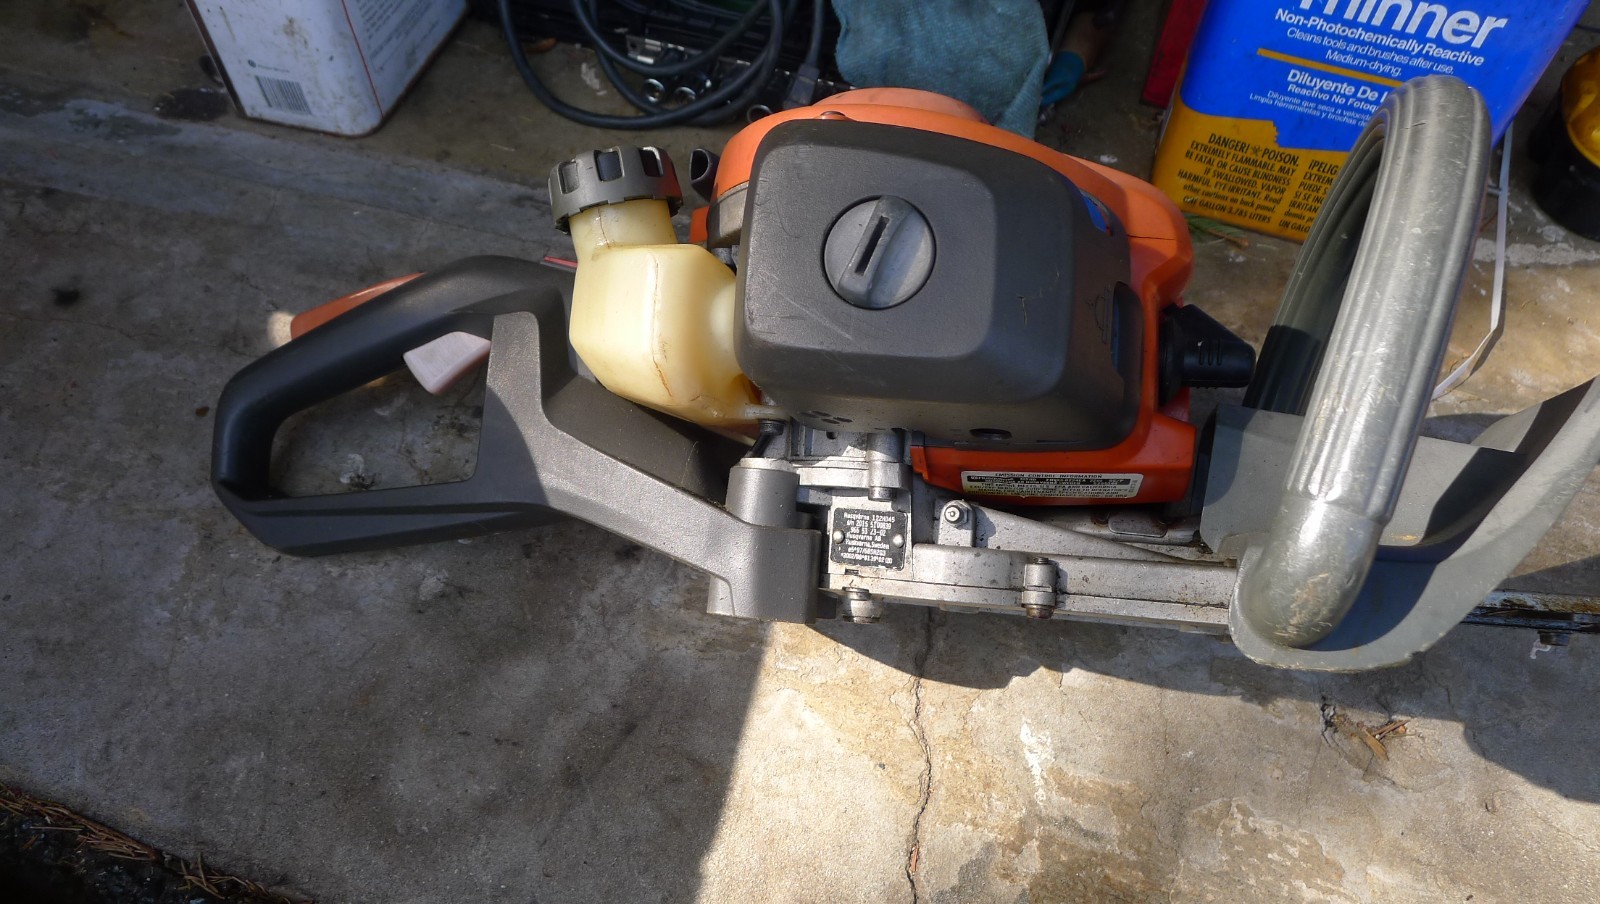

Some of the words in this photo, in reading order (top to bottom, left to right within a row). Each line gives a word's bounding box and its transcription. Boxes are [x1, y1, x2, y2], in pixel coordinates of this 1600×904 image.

[1275, 8, 1424, 55] Non-Photochemically
[1423, 43, 1485, 67] Reactive
[1299, 0, 1508, 49] inner
[1287, 27, 1322, 45] Cleans
[1323, 35, 1346, 51] tools
[1346, 41, 1368, 55] and
[1367, 44, 1409, 65] brushes
[1409, 55, 1433, 69] after
[1433, 61, 1454, 75] use.
[1325, 49, 1402, 78] Medium-drying.
[1287, 69, 1355, 96] Diluyente
[1356, 85, 1379, 102] De
[1287, 83, 1330, 101] Reactivo
[1331, 94, 1346, 105] No
[1249, 93, 1273, 105] Limpia
[1274, 99, 1320, 117] herramientas
[1328, 113, 1357, 126] brochas
[1267, 90, 1300, 105] Diluyente
[1302, 99, 1316, 109] que
[1317, 103, 1335, 112] seca
[1190, 140, 1231, 160] EXTREMELY
[1277, 165, 1297, 177] MAY
[1208, 133, 1251, 154] DANGER!
[1261, 148, 1299, 168] POISON.
[1185, 150, 1194, 159] BE
[1194, 152, 1216, 166] FATAL
[1216, 159, 1228, 169] OR
[1229, 163, 1251, 178] CAUSE
[1252, 169, 1292, 187] BLINDNESS
[1204, 167, 1211, 176] IF
[1212, 169, 1258, 190] SWALLOWED.
[1261, 182, 1286, 196] VAPOR
[1303, 171, 1334, 186] EXTREM
[1183, 183, 1201, 195] other
[1213, 180, 1228, 191] EYE
[1228, 184, 1262, 200] IRRITANT.
[1264, 193, 1283, 205] Read
[1294, 191, 1302, 199] SI
[1303, 193, 1312, 202] SE
[1298, 181, 1322, 194] PUEDE
[1199, 200, 1227, 213] GALLON
[1248, 210, 1271, 224] LITERS
[1278, 219, 1290, 228] UN
